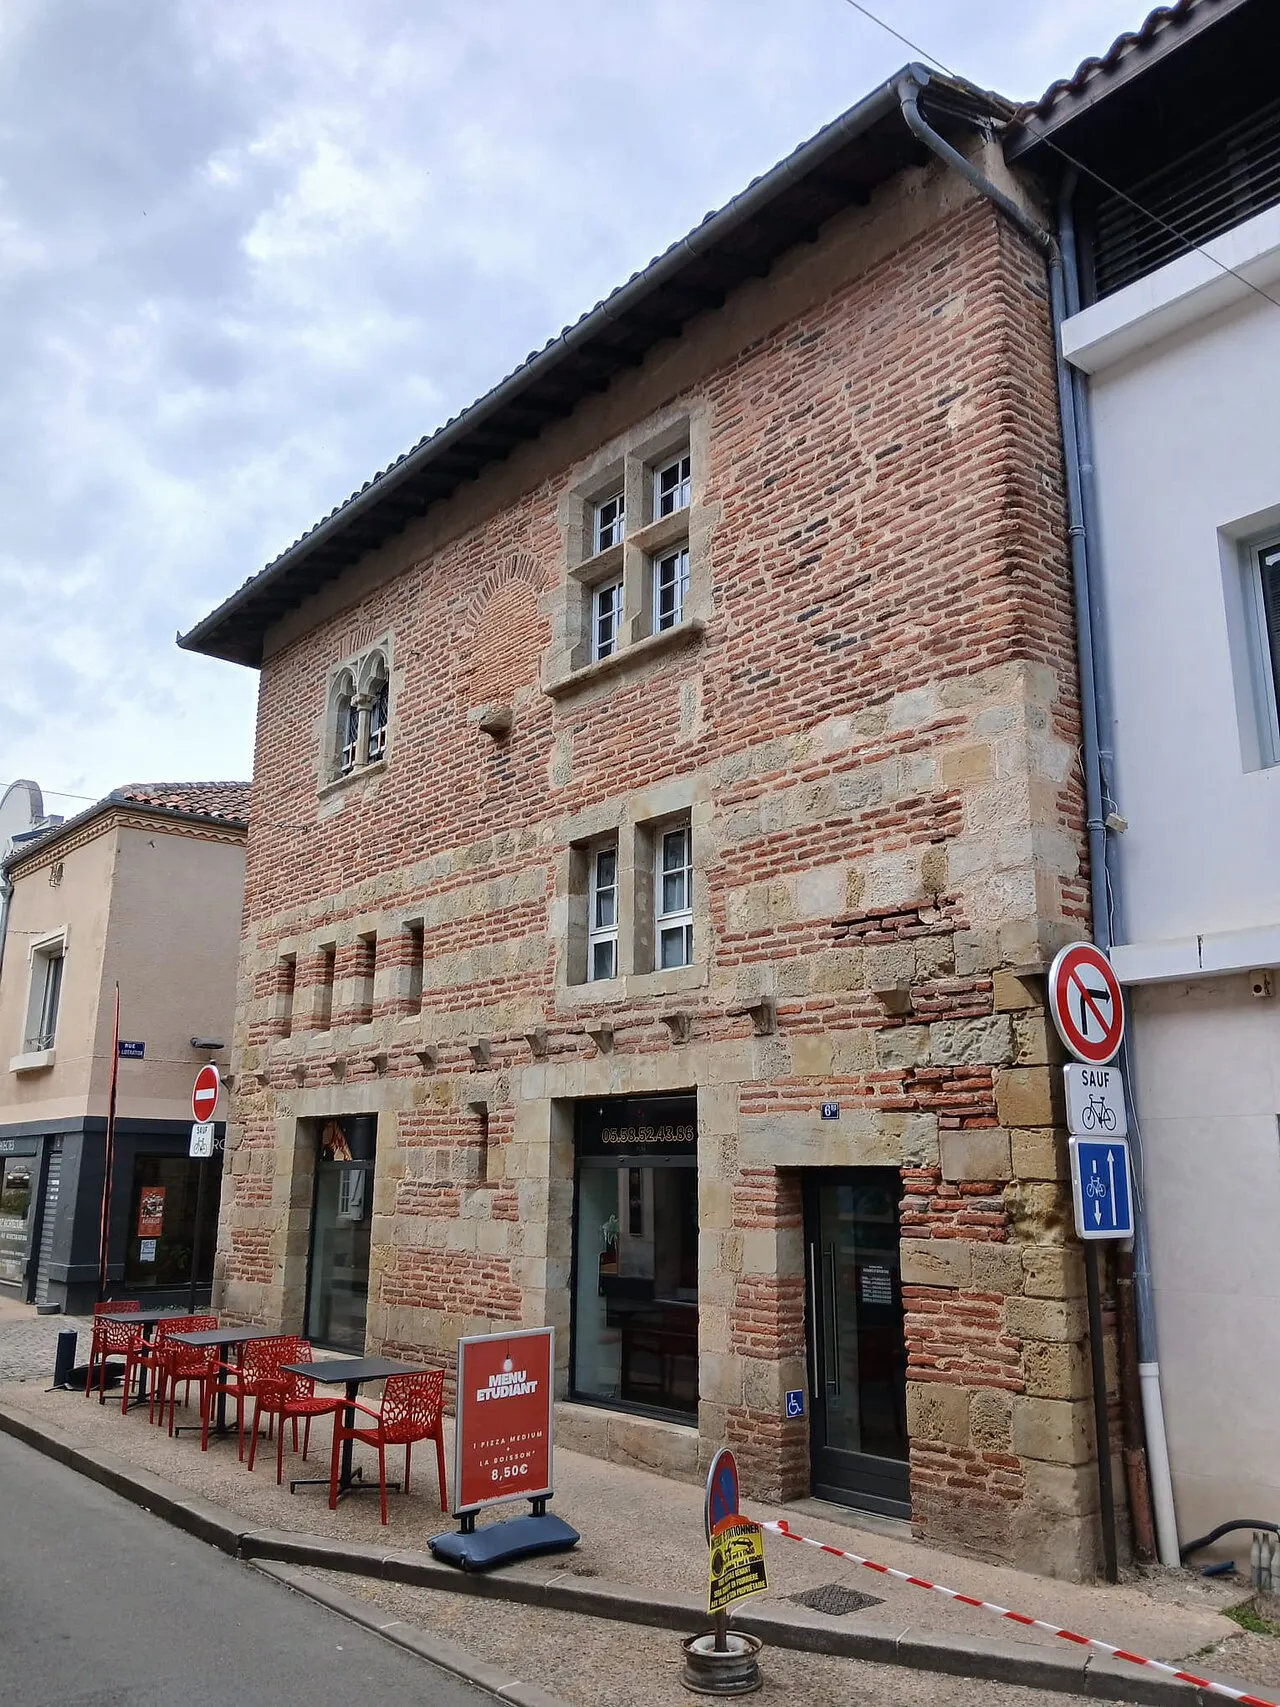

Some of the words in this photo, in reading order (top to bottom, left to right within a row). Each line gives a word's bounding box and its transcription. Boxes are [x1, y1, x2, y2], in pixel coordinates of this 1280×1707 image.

[1081, 1069, 1110, 1088] SAUF
[196, 1126, 208, 1134] SAUF
[601, 1125, 695, 1143] 05.58.52.43.86
[488, 1370, 527, 1388] MENU
[476, 1380, 538, 1402] ETUDIANT
[480, 1437, 506, 1449] PIZZA
[509, 1430, 543, 1443] MEDIUM
[491, 1463, 529, 1482] 8,50€
